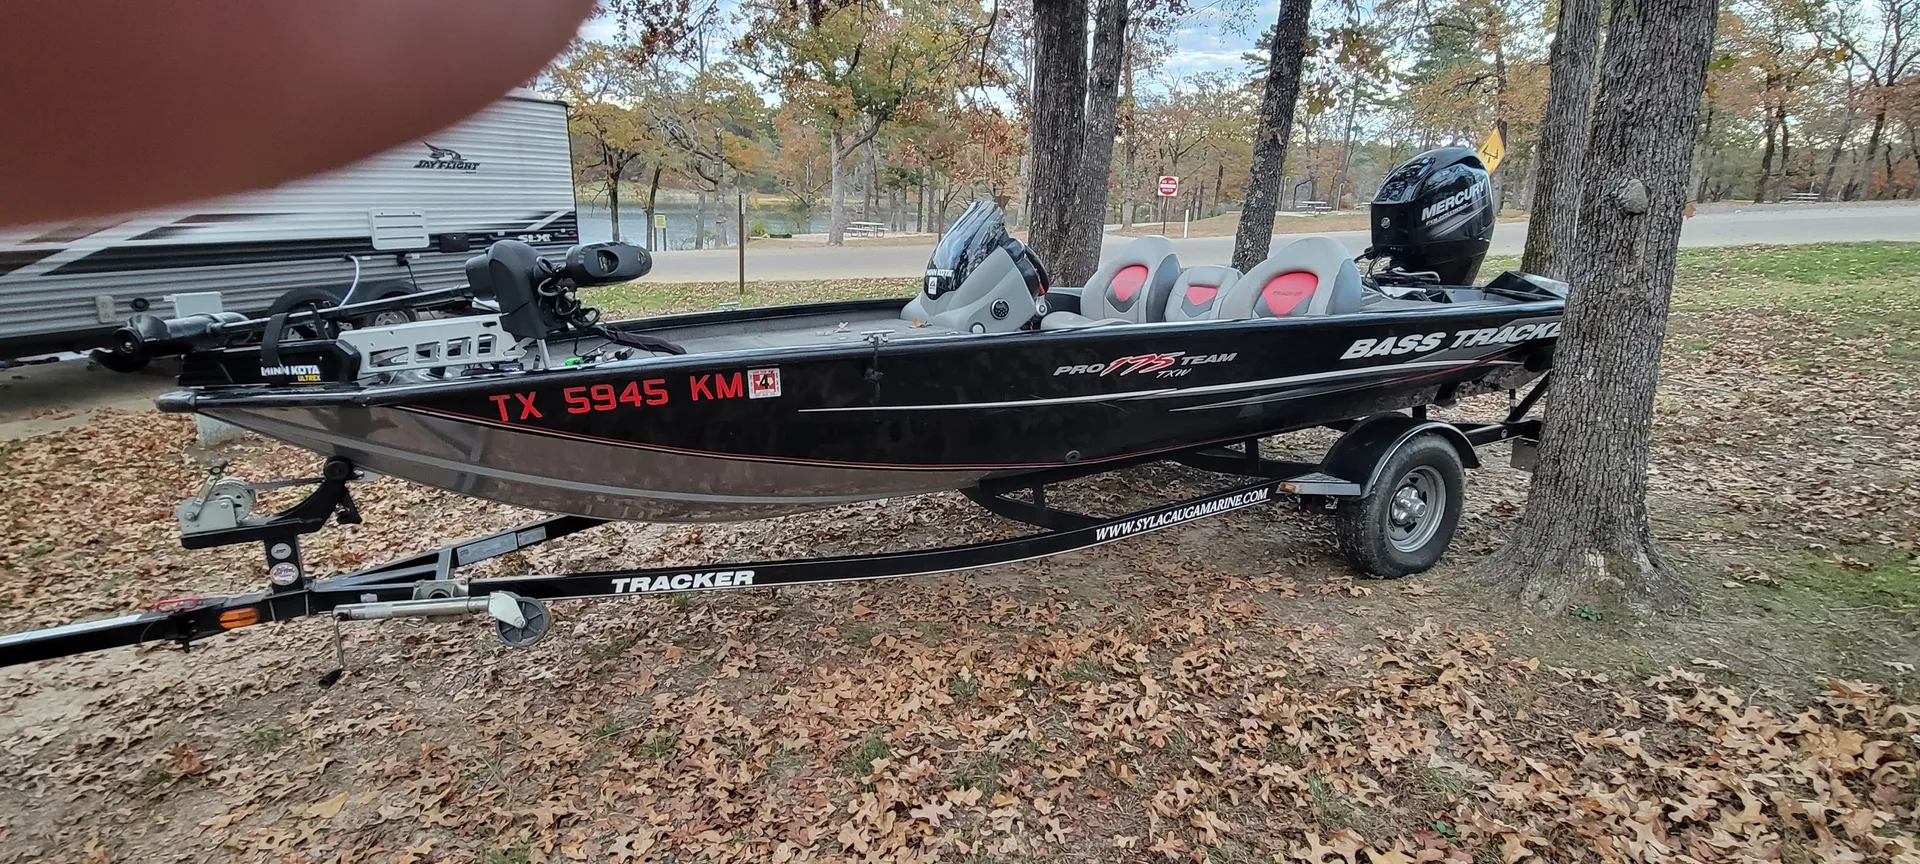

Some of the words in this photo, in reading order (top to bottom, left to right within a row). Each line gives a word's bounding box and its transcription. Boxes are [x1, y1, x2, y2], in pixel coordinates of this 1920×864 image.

[413, 160, 438, 168] JAY
[437, 160, 480, 170] FLIGHT
[1421, 178, 1486, 221] MERCURY
[1340, 331, 1447, 360] BASS
[260, 366, 290, 376] MINN
[290, 364, 320, 375] KOTA
[1053, 364, 1106, 376] PRO
[1100, 351, 1186, 377] 175
[1181, 352, 1238, 366] TEAM
[760, 373, 770, 389] 4
[489, 391, 543, 421] TX
[563, 378, 669, 414] 5945
[689, 372, 744, 401] KM
[1095, 487, 1269, 541] WWW.SYLACAUGAMARINE.COM
[611, 570, 756, 594] TRACKER
